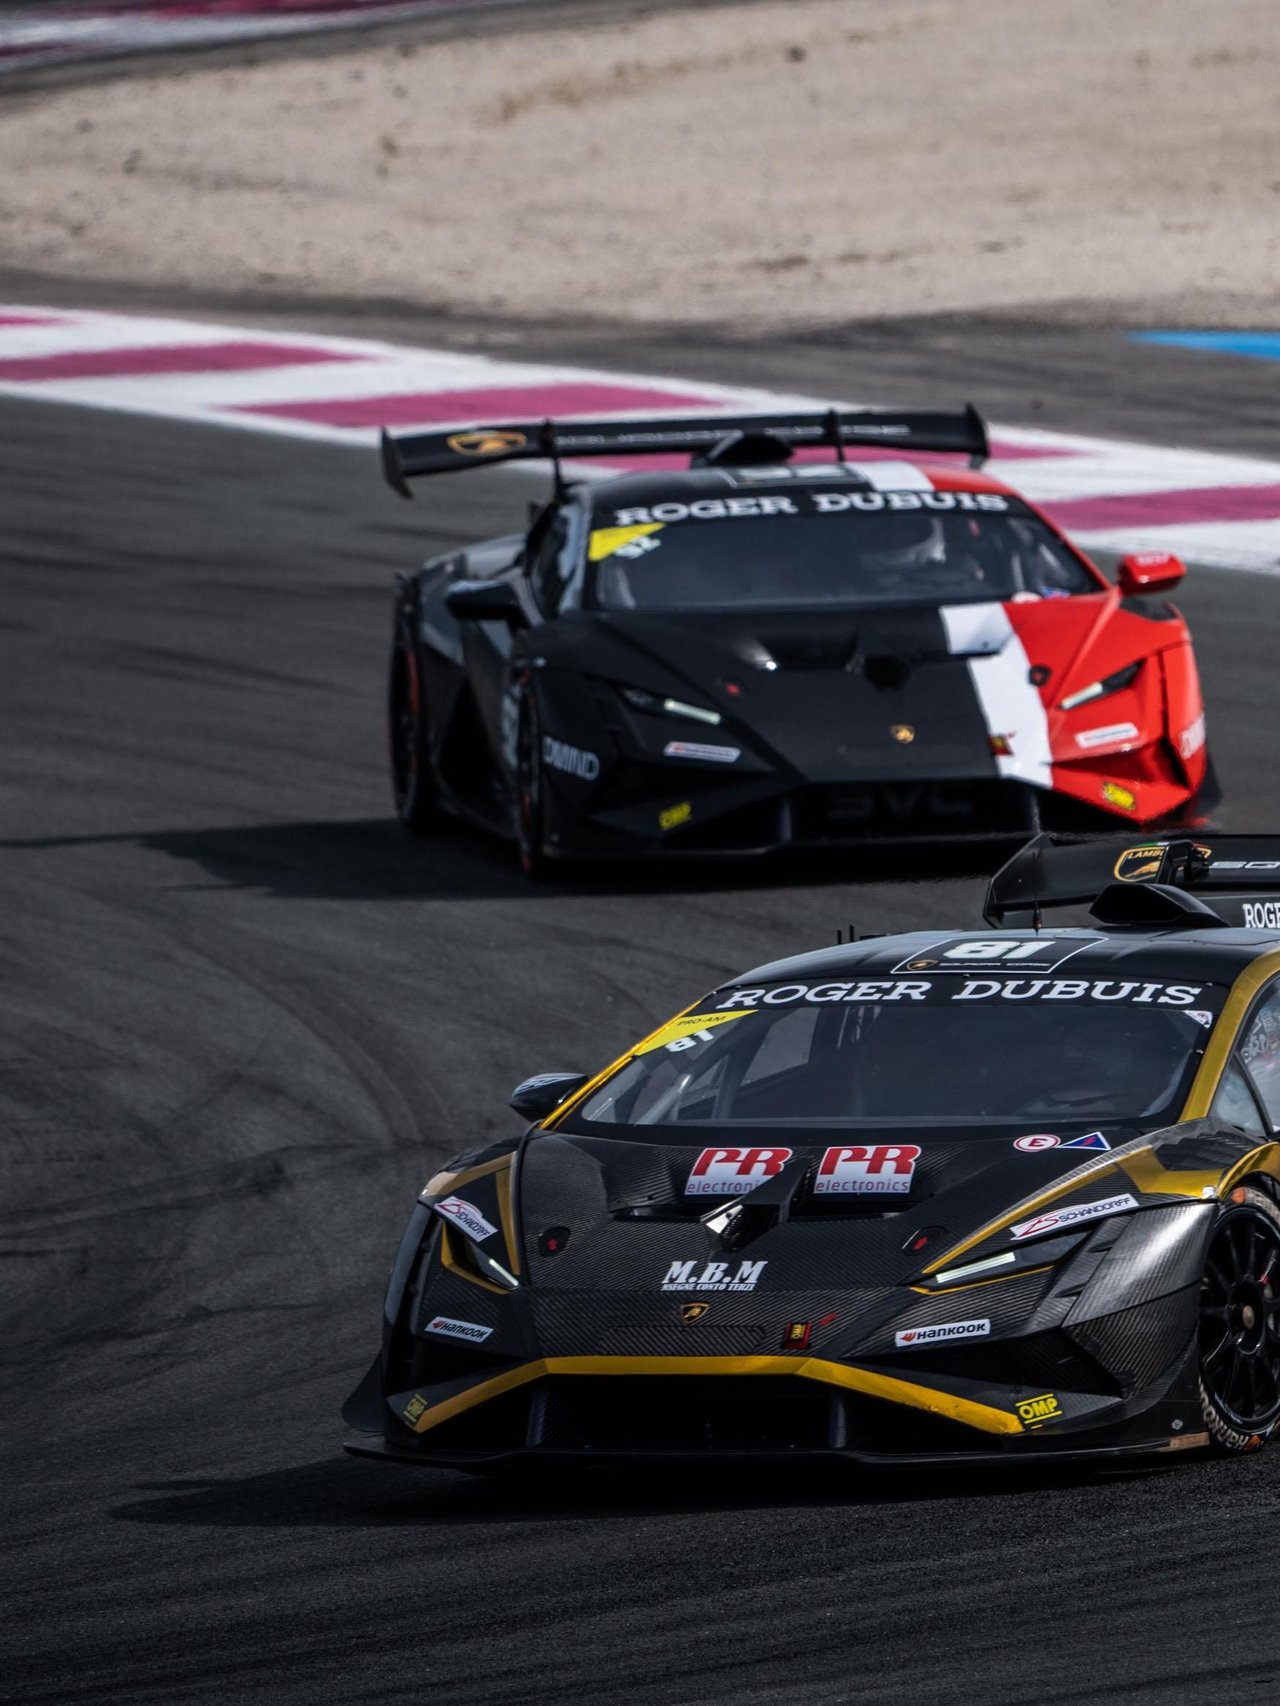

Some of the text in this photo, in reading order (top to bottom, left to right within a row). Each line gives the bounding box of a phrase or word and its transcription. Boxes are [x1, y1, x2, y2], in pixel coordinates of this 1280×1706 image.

[615, 491, 1009, 526] ROGER DUBUIS
[942, 940, 1056, 960] 81
[716, 979, 1203, 1010] ROGER DUBUIS
[677, 1015, 728, 1028] PRO-AM
[665, 1028, 715, 1053] 81
[692, 1147, 792, 1177] PR
[819, 1145, 921, 1175] PR
[687, 1179, 761, 1194] electroni
[816, 1178, 910, 1193] electronics
[1059, 1197, 1131, 1223] SCHANDORFF
[455, 1211, 490, 1237] SCHANDORFF
[696, 1283, 727, 1291] CONTO
[728, 1283, 756, 1291] TERZI
[1019, 1397, 1059, 1420] OMP
